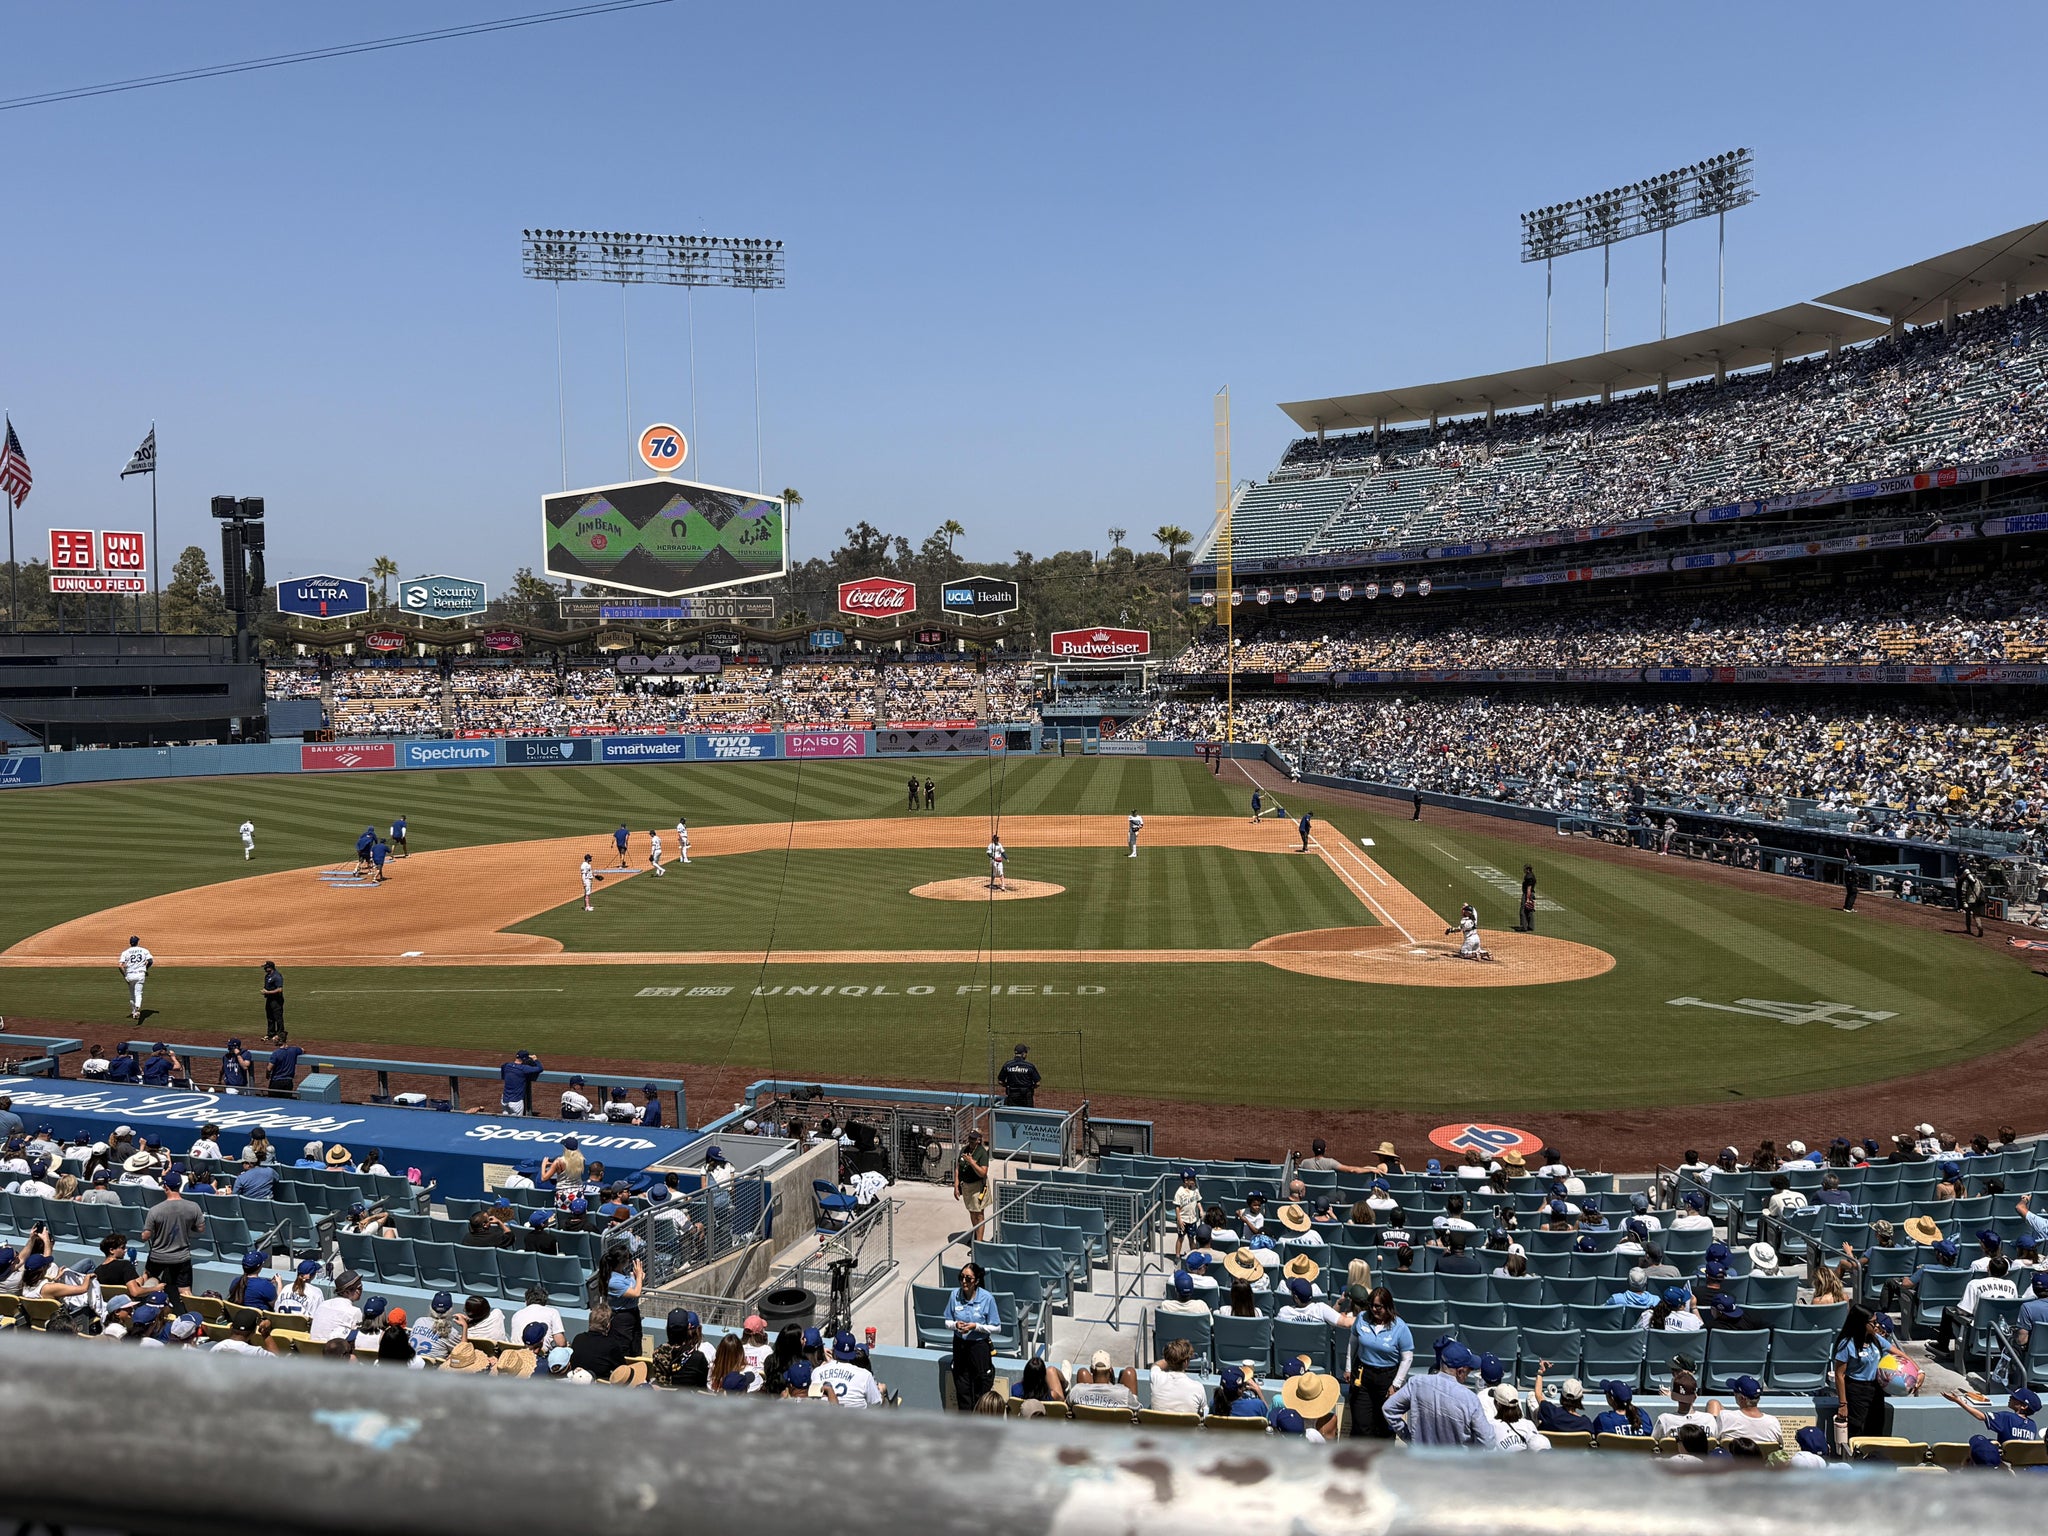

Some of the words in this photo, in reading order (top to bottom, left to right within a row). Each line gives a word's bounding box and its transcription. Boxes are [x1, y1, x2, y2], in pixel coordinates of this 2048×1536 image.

[650, 436, 678, 457] 76
[1971, 464, 1999, 480] JINRO
[1880, 479, 1911, 493] SVEDKA
[1709, 505, 1741, 521] CONCESSIONS
[575, 521, 594, 537] JIM
[595, 518, 622, 537] BEAM
[108, 537, 137, 550] UNI
[108, 553, 140, 567] QLO
[1685, 554, 1715, 569] CONCESSIONS
[1545, 573, 1566, 581] SVEDKA
[57, 579, 102, 592] UNIQLO
[106, 580, 141, 591] FIELD
[305, 579, 341, 588] Michelob
[298, 588, 349, 600] ULTRA
[432, 586, 479, 599] Security
[846, 588, 907, 608] Coca-Cola
[948, 593, 973, 602] UCLA
[978, 591, 1012, 602] Health
[433, 598, 473, 609] Benefit
[709, 605, 715, 616] 0
[718, 605, 724, 616] 0
[727, 605, 734, 616] 0
[367, 636, 404, 647] Churu
[813, 632, 840, 645] TEL
[1062, 641, 1140, 655] Budweiser
[1660, 669, 1692, 682] CONCESSIONS
[1748, 670, 1767, 680] JINRO
[2001, 670, 2038, 678] SYNCRON
[1102, 721, 1114, 731] 76
[707, 736, 750, 748] TOYO
[793, 737, 839, 746] DAISO
[991, 737, 1003, 746] 76
[411, 746, 484, 763] Spectrum
[527, 743, 559, 756] blue
[607, 743, 681, 755] smartwater
[714, 746, 760, 757] TIRES
[130, 954, 142, 963] 23
[751, 985, 936, 996] UNIQLO
[956, 985, 1107, 996] FIELD
[94, 1093, 365, 1133] Dodgers
[1450, 1124, 1523, 1154] 76
[1783, 1196, 1807, 1208] 50
[1382, 1230, 1411, 1241] STRIDER
[1664, 1318, 1682, 1328] HTANI
[819, 1368, 855, 1382] KERSHAW
